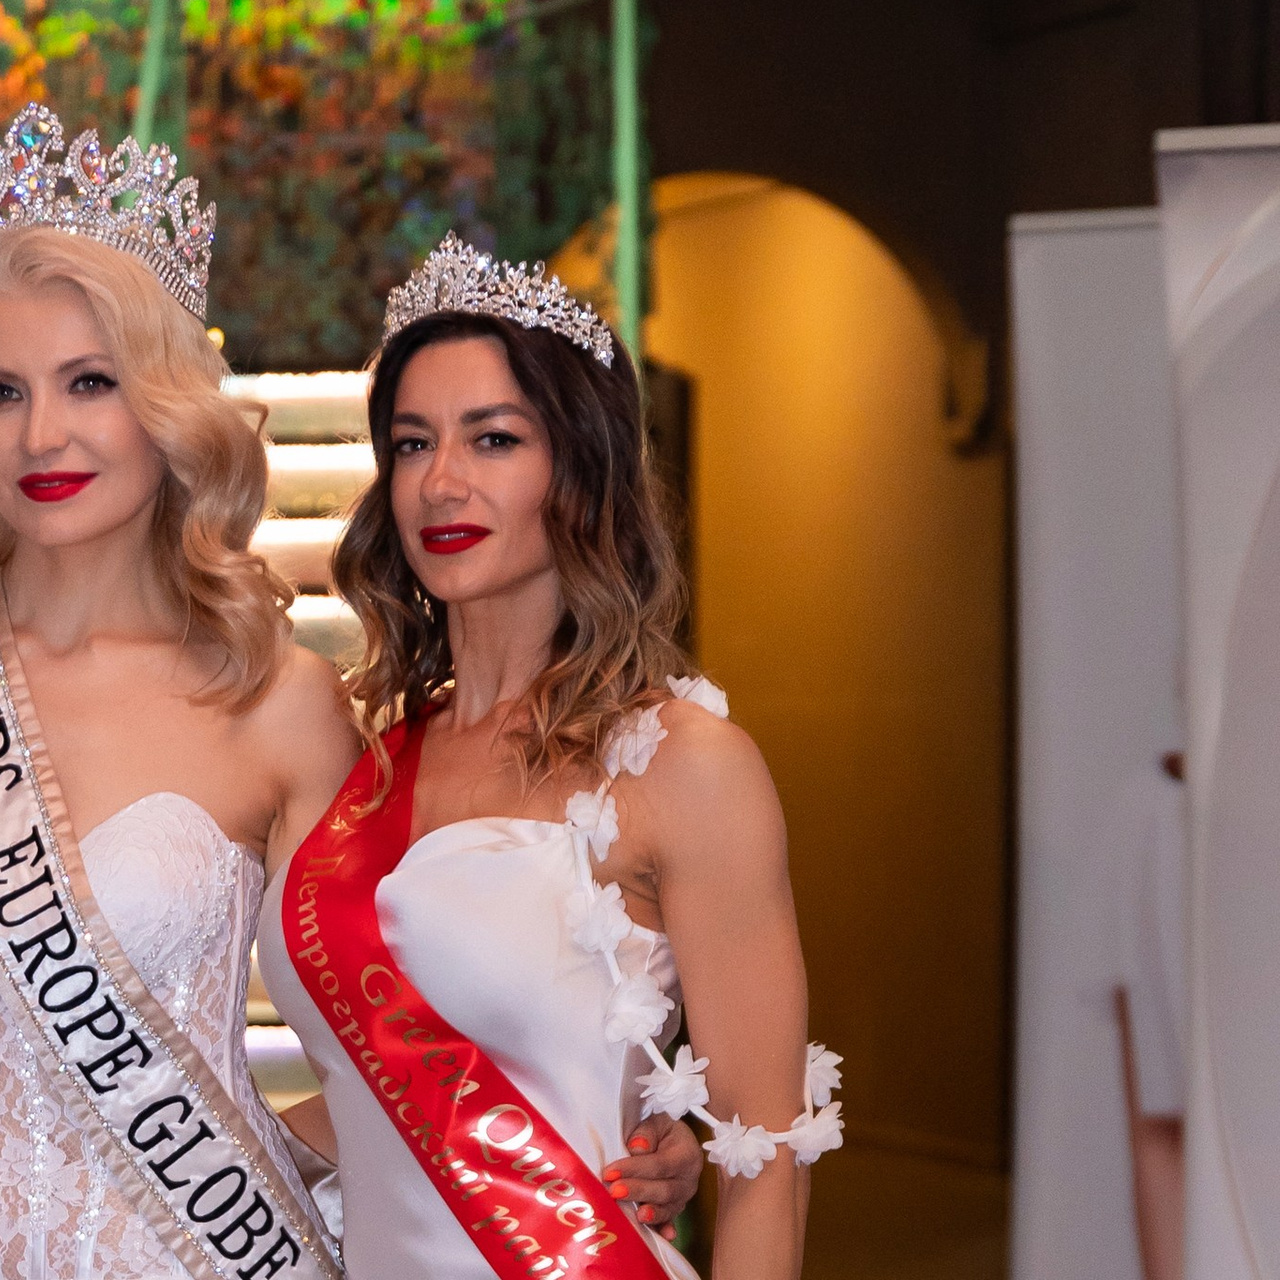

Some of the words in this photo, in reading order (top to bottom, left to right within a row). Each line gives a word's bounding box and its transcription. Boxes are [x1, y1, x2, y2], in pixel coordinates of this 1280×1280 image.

[297, 853, 488, 1200] Петроградский
[360, 963, 482, 1106] Green
[467, 1103, 618, 1257] Queen
